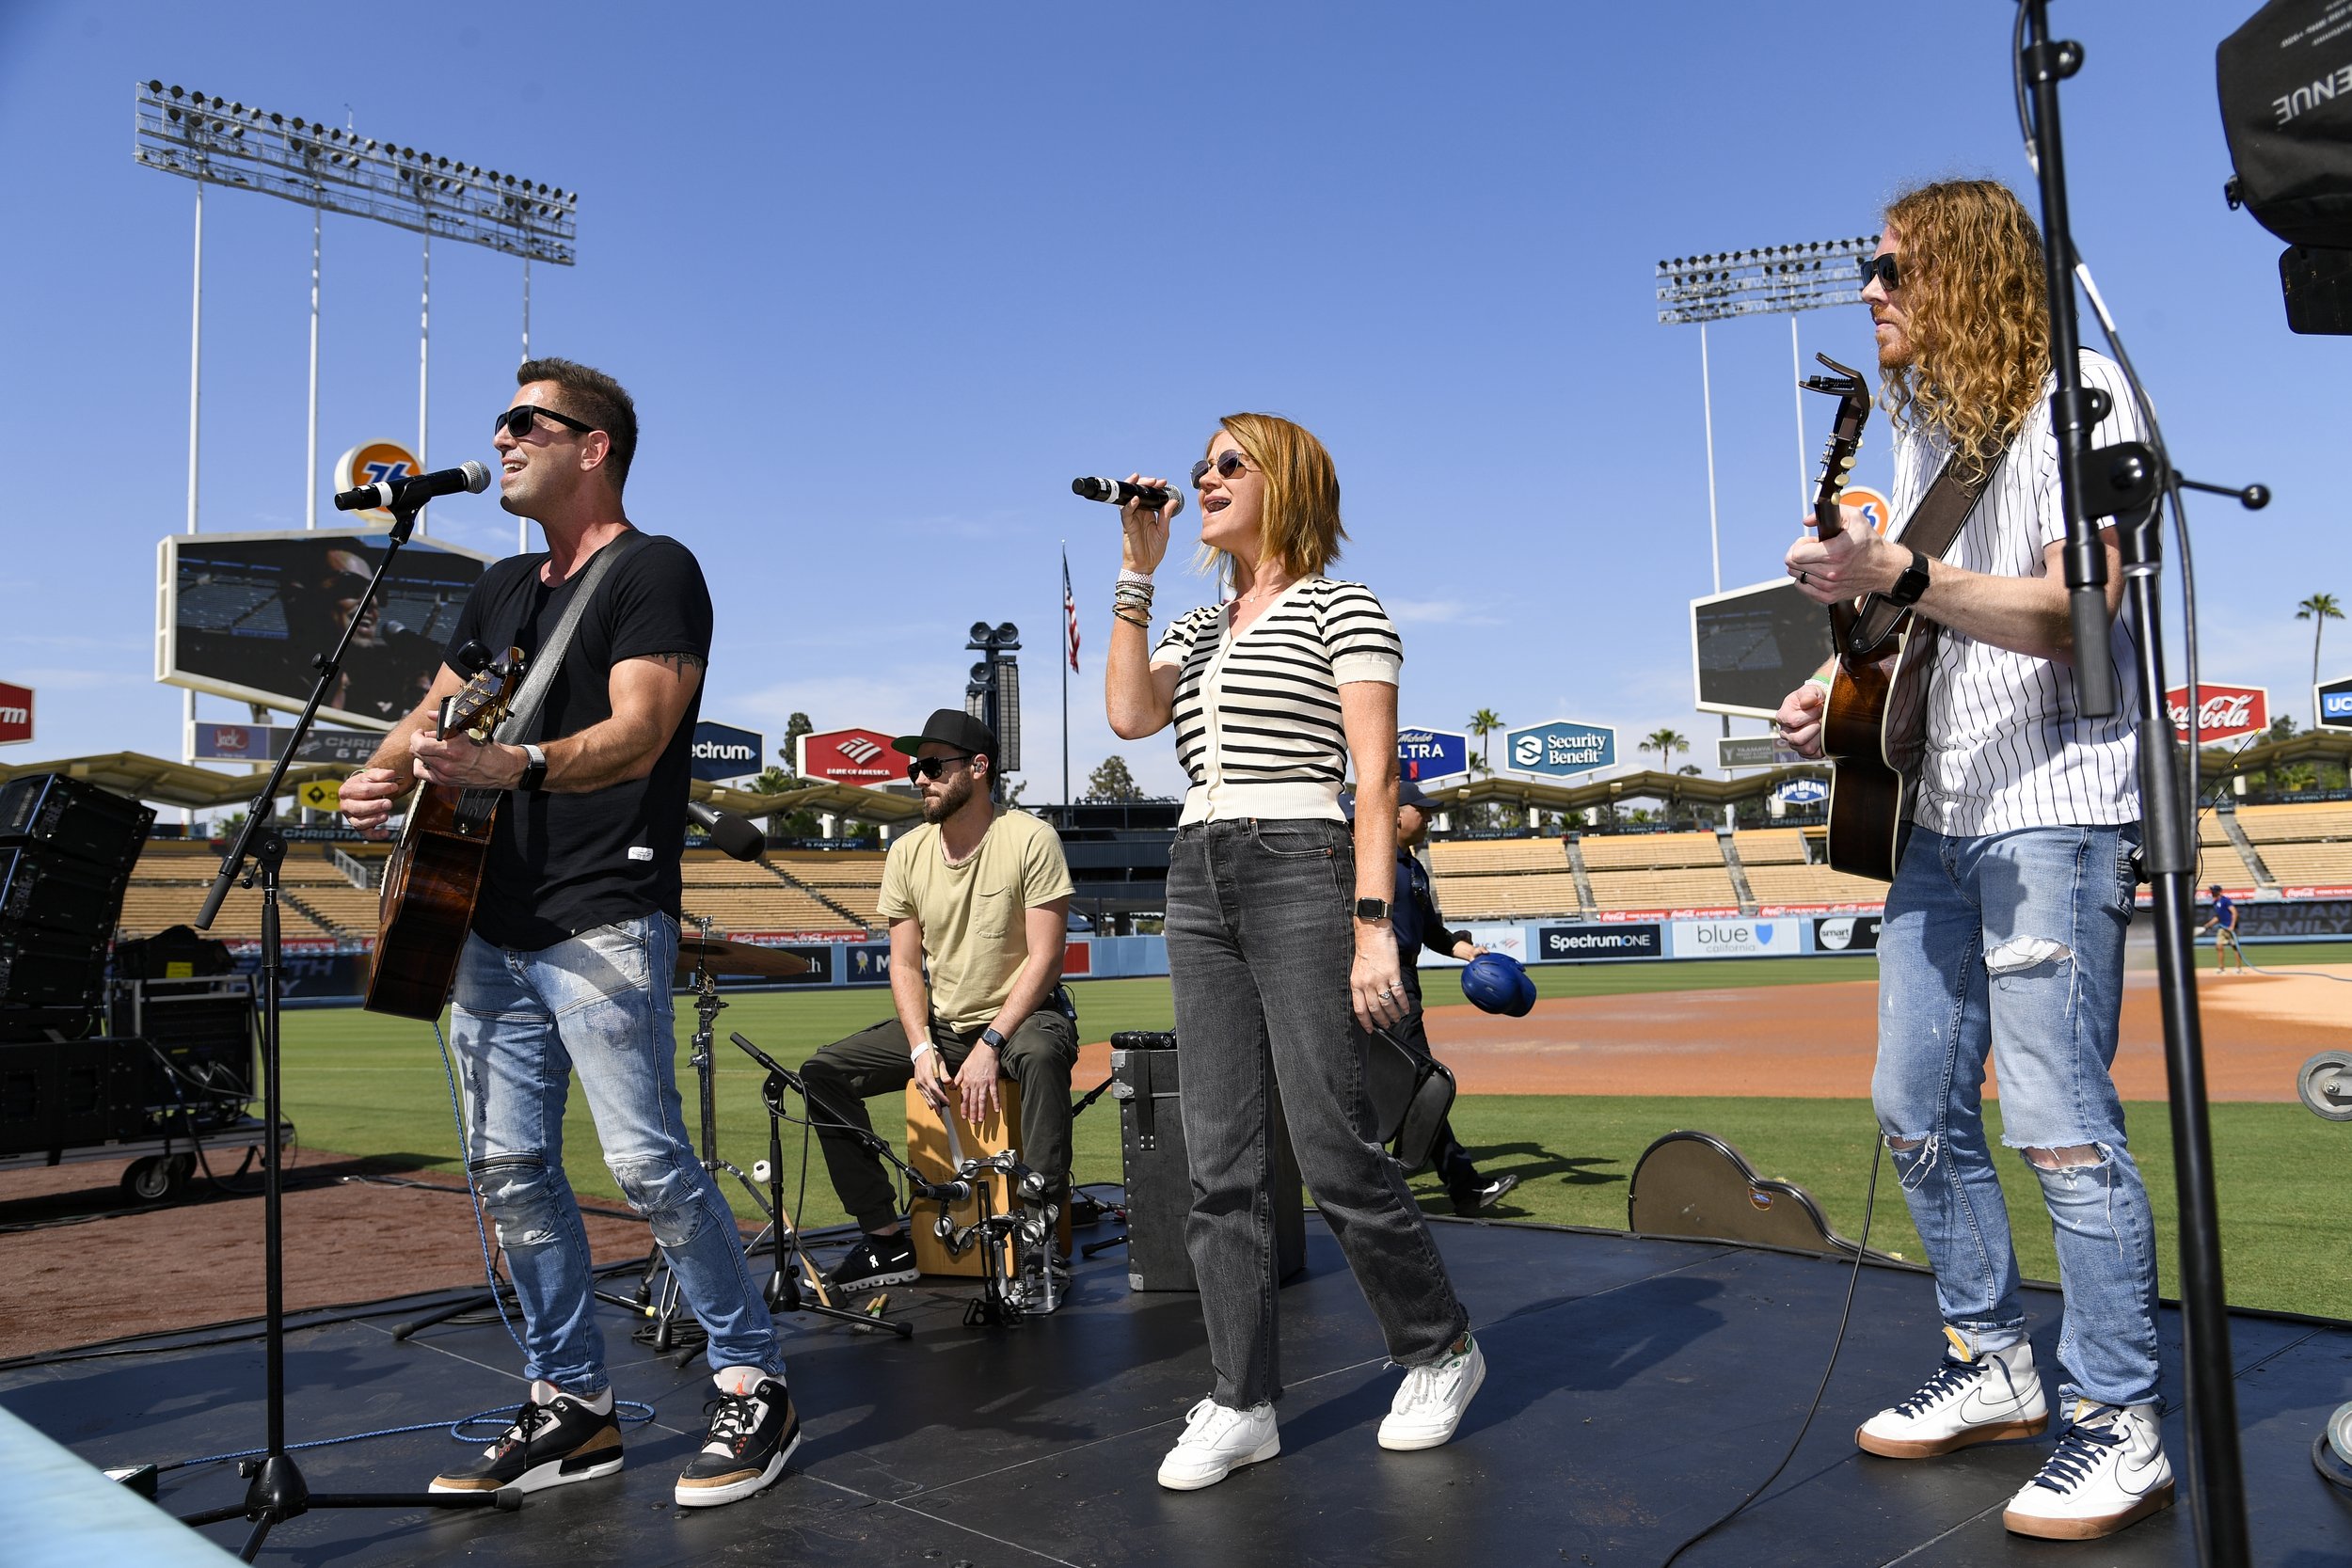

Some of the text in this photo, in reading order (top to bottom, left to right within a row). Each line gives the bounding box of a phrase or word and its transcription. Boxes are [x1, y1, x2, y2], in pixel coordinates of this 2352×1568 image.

[325, 736, 380, 749] CHRIS
[1548, 733, 1607, 750] Security
[356, 749, 372, 759] F
[691, 740, 751, 760] ectrum
[1398, 743, 1445, 758] LTRA
[1549, 749, 1599, 765] Benefit
[859, 768, 890, 776] AMERICA
[1779, 784, 1799, 800] JIM
[1797, 779, 1826, 797] BEAM
[1770, 816, 1827, 826] CHRISTI
[282, 829, 363, 840] CHRISTIA
[1602, 911, 1626, 922] Coca-Cola
[1697, 924, 1748, 944] blue
[1821, 928, 1849, 937] smart
[2238, 919, 2350, 935] FAMILY
[1706, 942, 1756, 953] california
[805, 958, 821, 974] th
